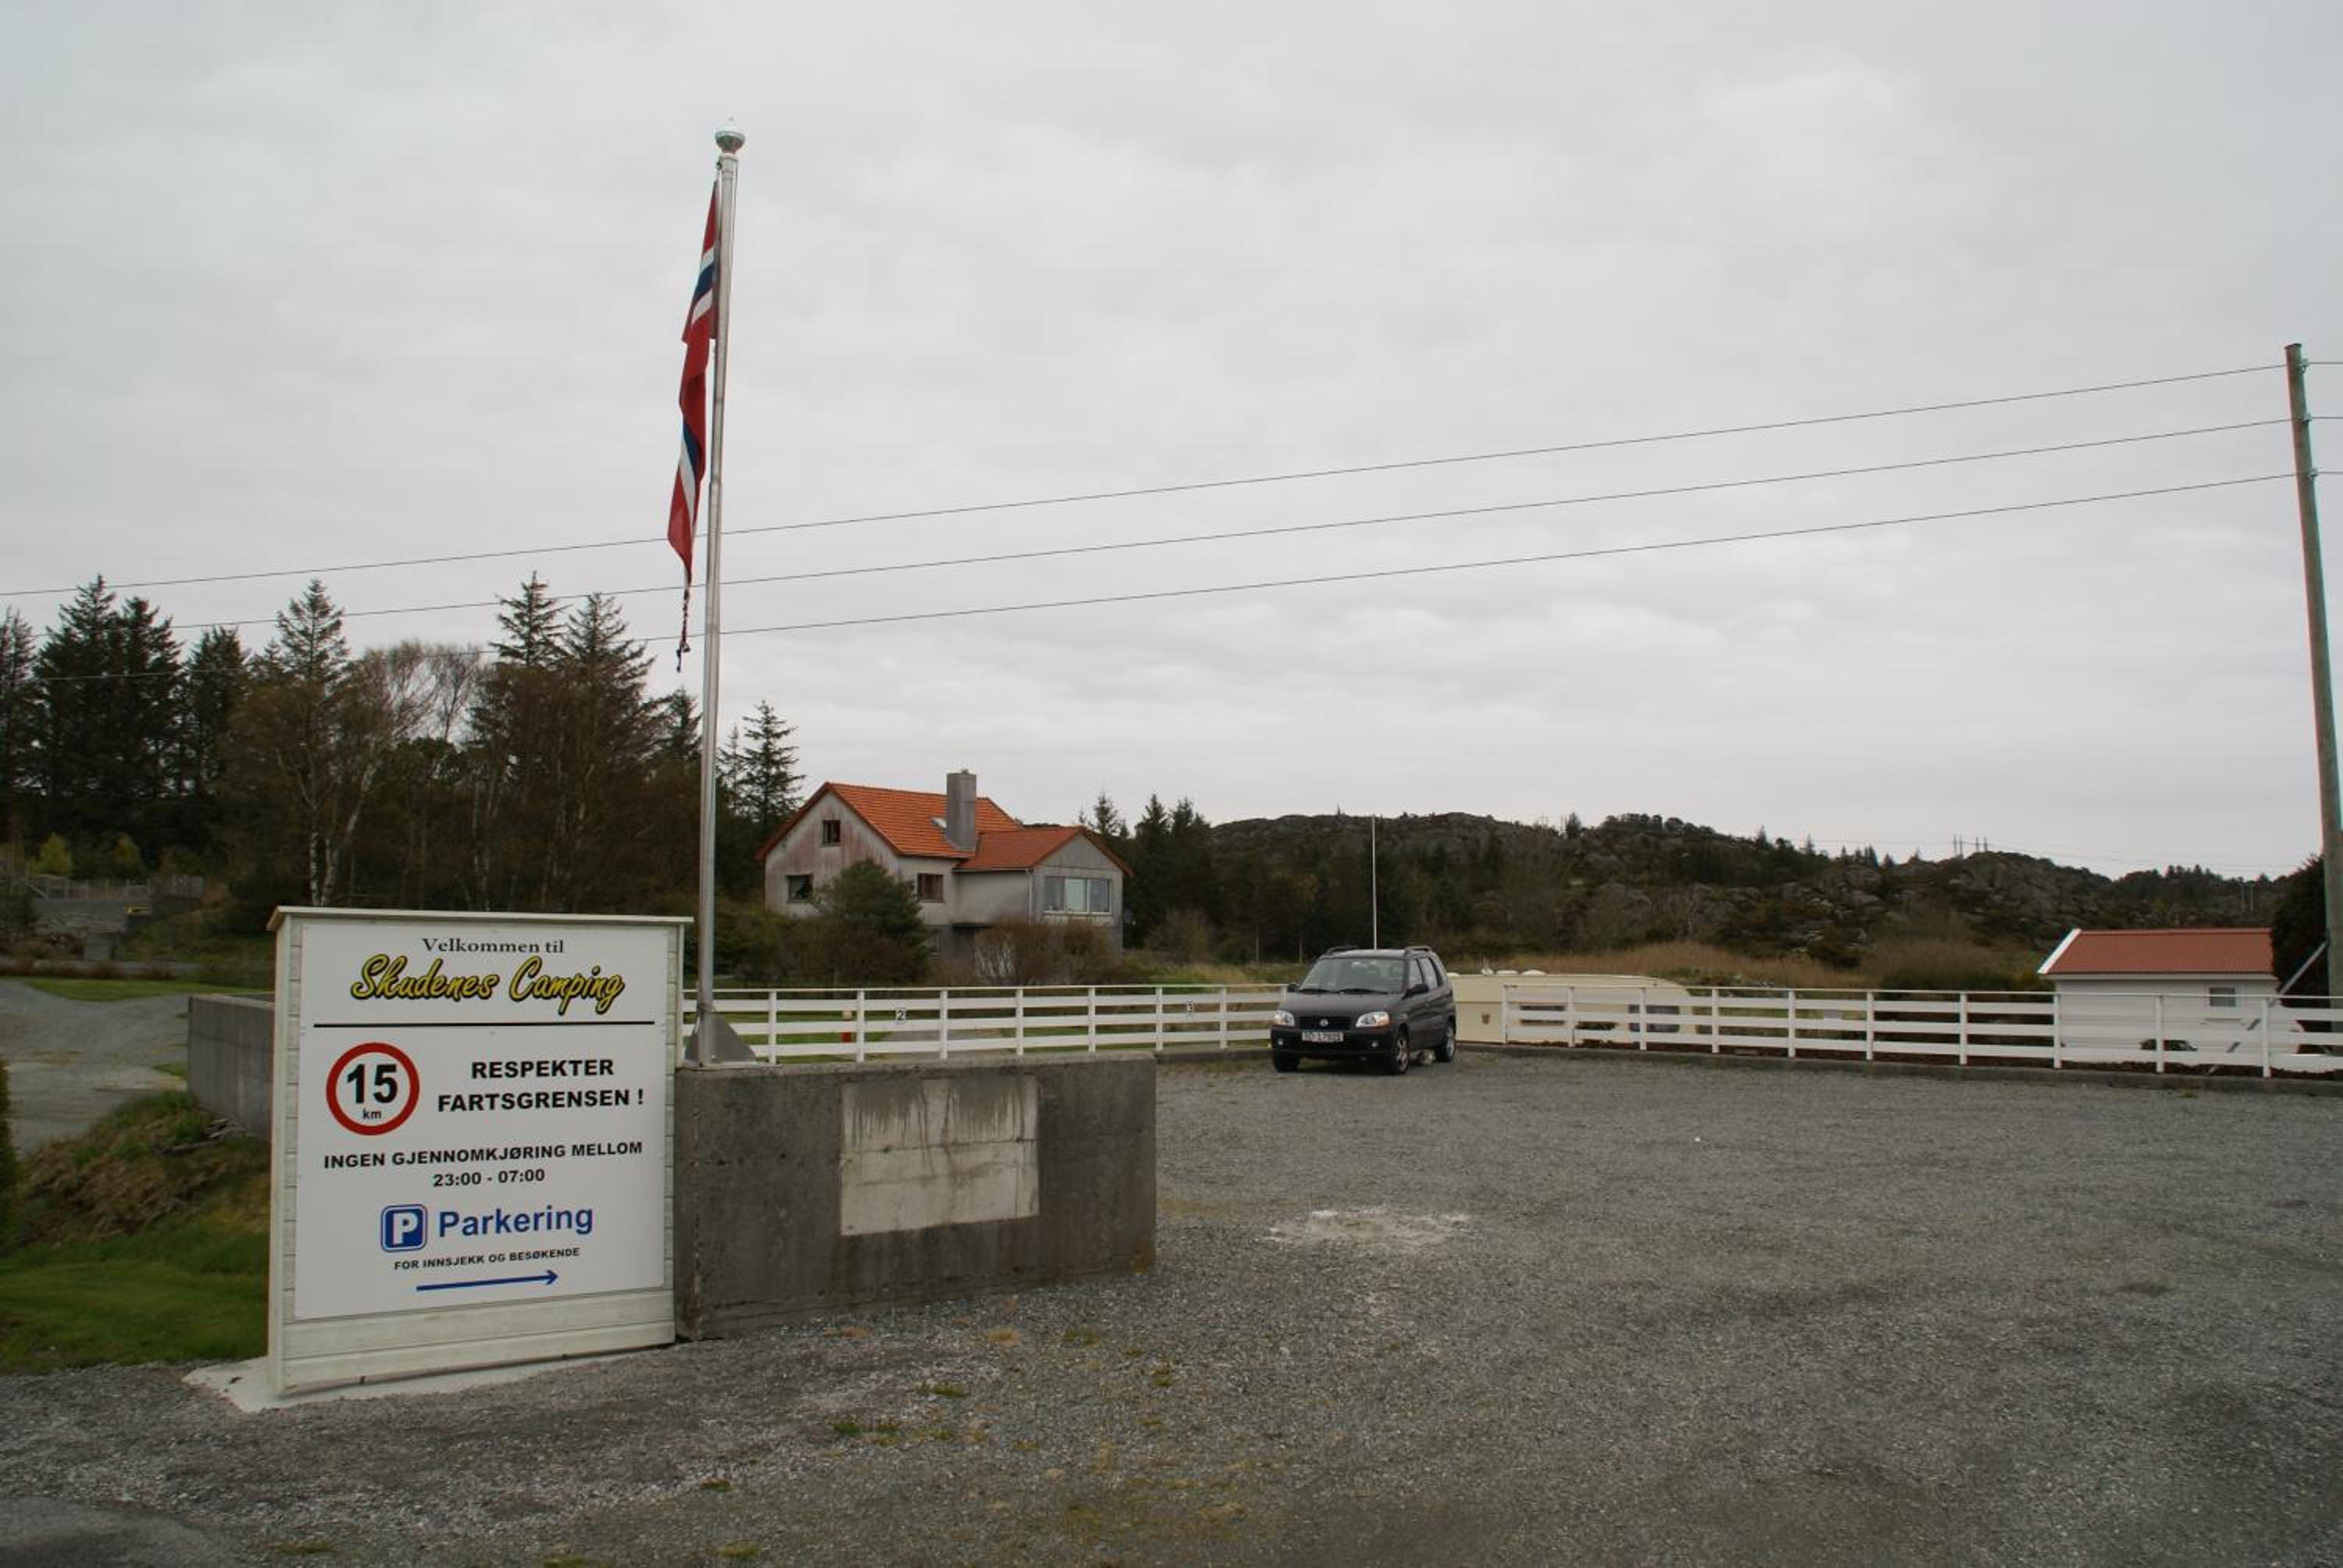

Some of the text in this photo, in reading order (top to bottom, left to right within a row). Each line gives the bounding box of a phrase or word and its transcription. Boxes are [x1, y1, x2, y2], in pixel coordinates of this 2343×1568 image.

[422, 937, 565, 953] Velkommen til
[351, 953, 625, 1015] Skudenes Camping
[471, 1059, 615, 1079] RESPEKTER
[346, 1063, 399, 1104] 15
[437, 1089, 629, 1113] FARTSGRENSEN
[362, 1108, 382, 1121] km
[324, 1141, 643, 1169] INGEN GJENNOMKJØRING MELLOM
[433, 1171, 482, 1188] 23:00
[498, 1168, 545, 1184] 07:00
[392, 1205, 593, 1245] P Parkering
[394, 1247, 580, 1270] FOR INNSJEKK OG BESØKENDE
